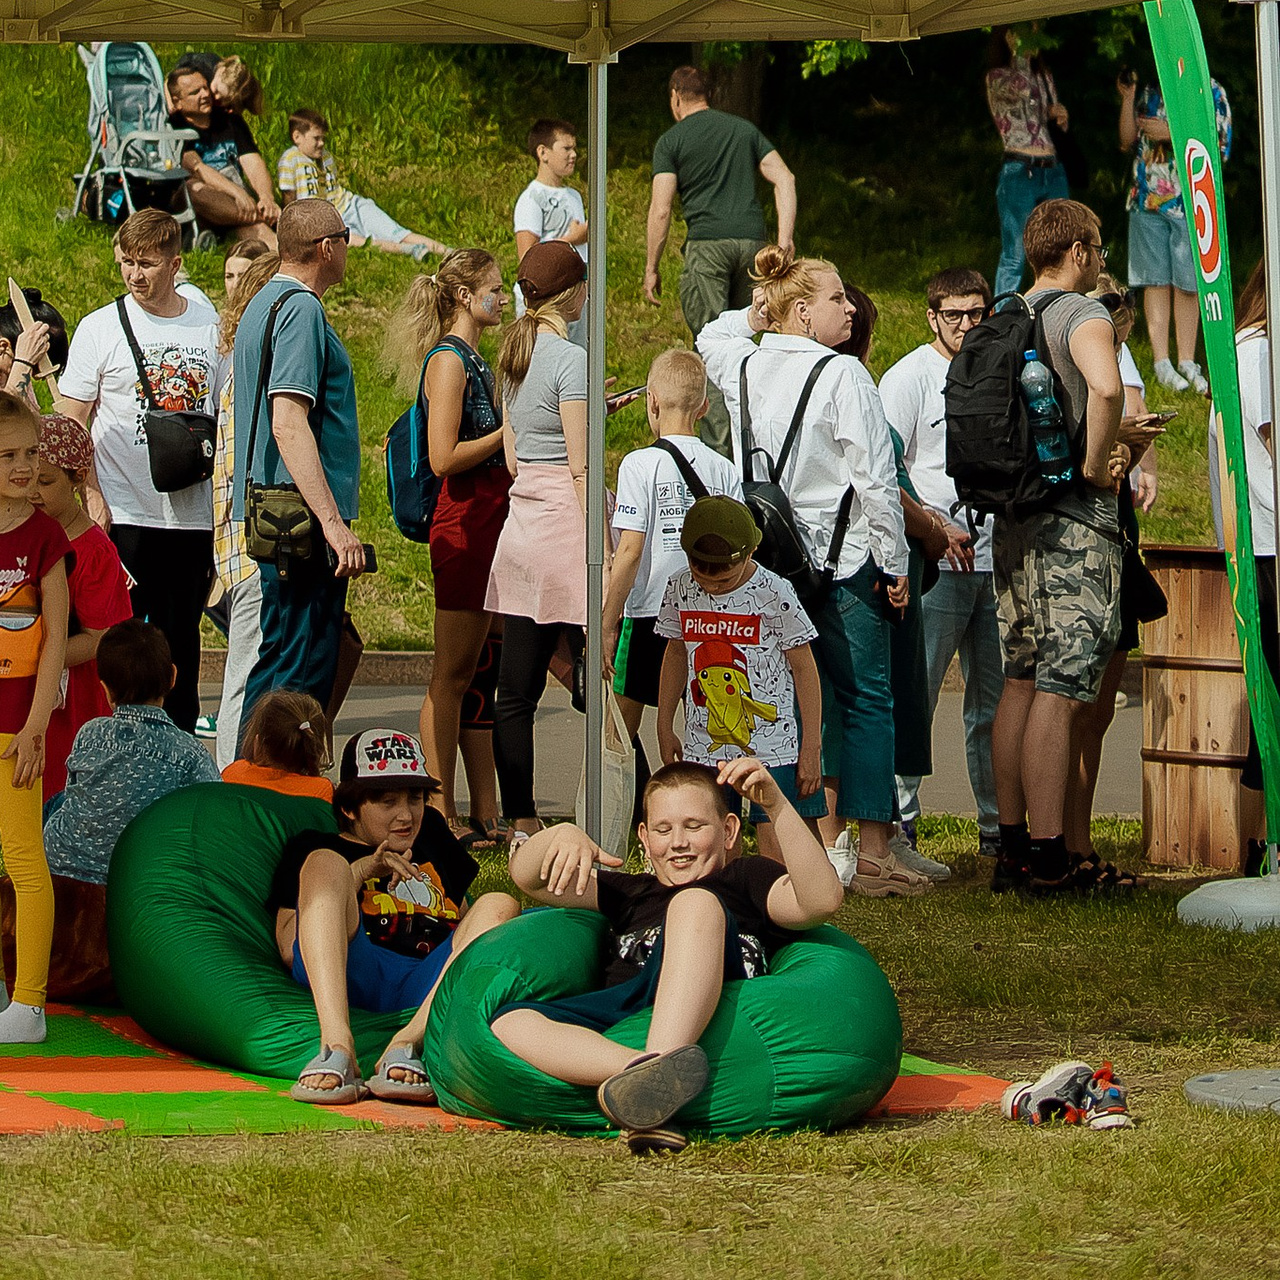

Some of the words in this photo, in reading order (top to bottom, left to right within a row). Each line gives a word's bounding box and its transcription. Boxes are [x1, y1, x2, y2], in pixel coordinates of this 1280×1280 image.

[618, 504, 637, 515] ПСБ
[685, 618, 755, 638] PikaPika
[365, 748, 418, 762] WARS
